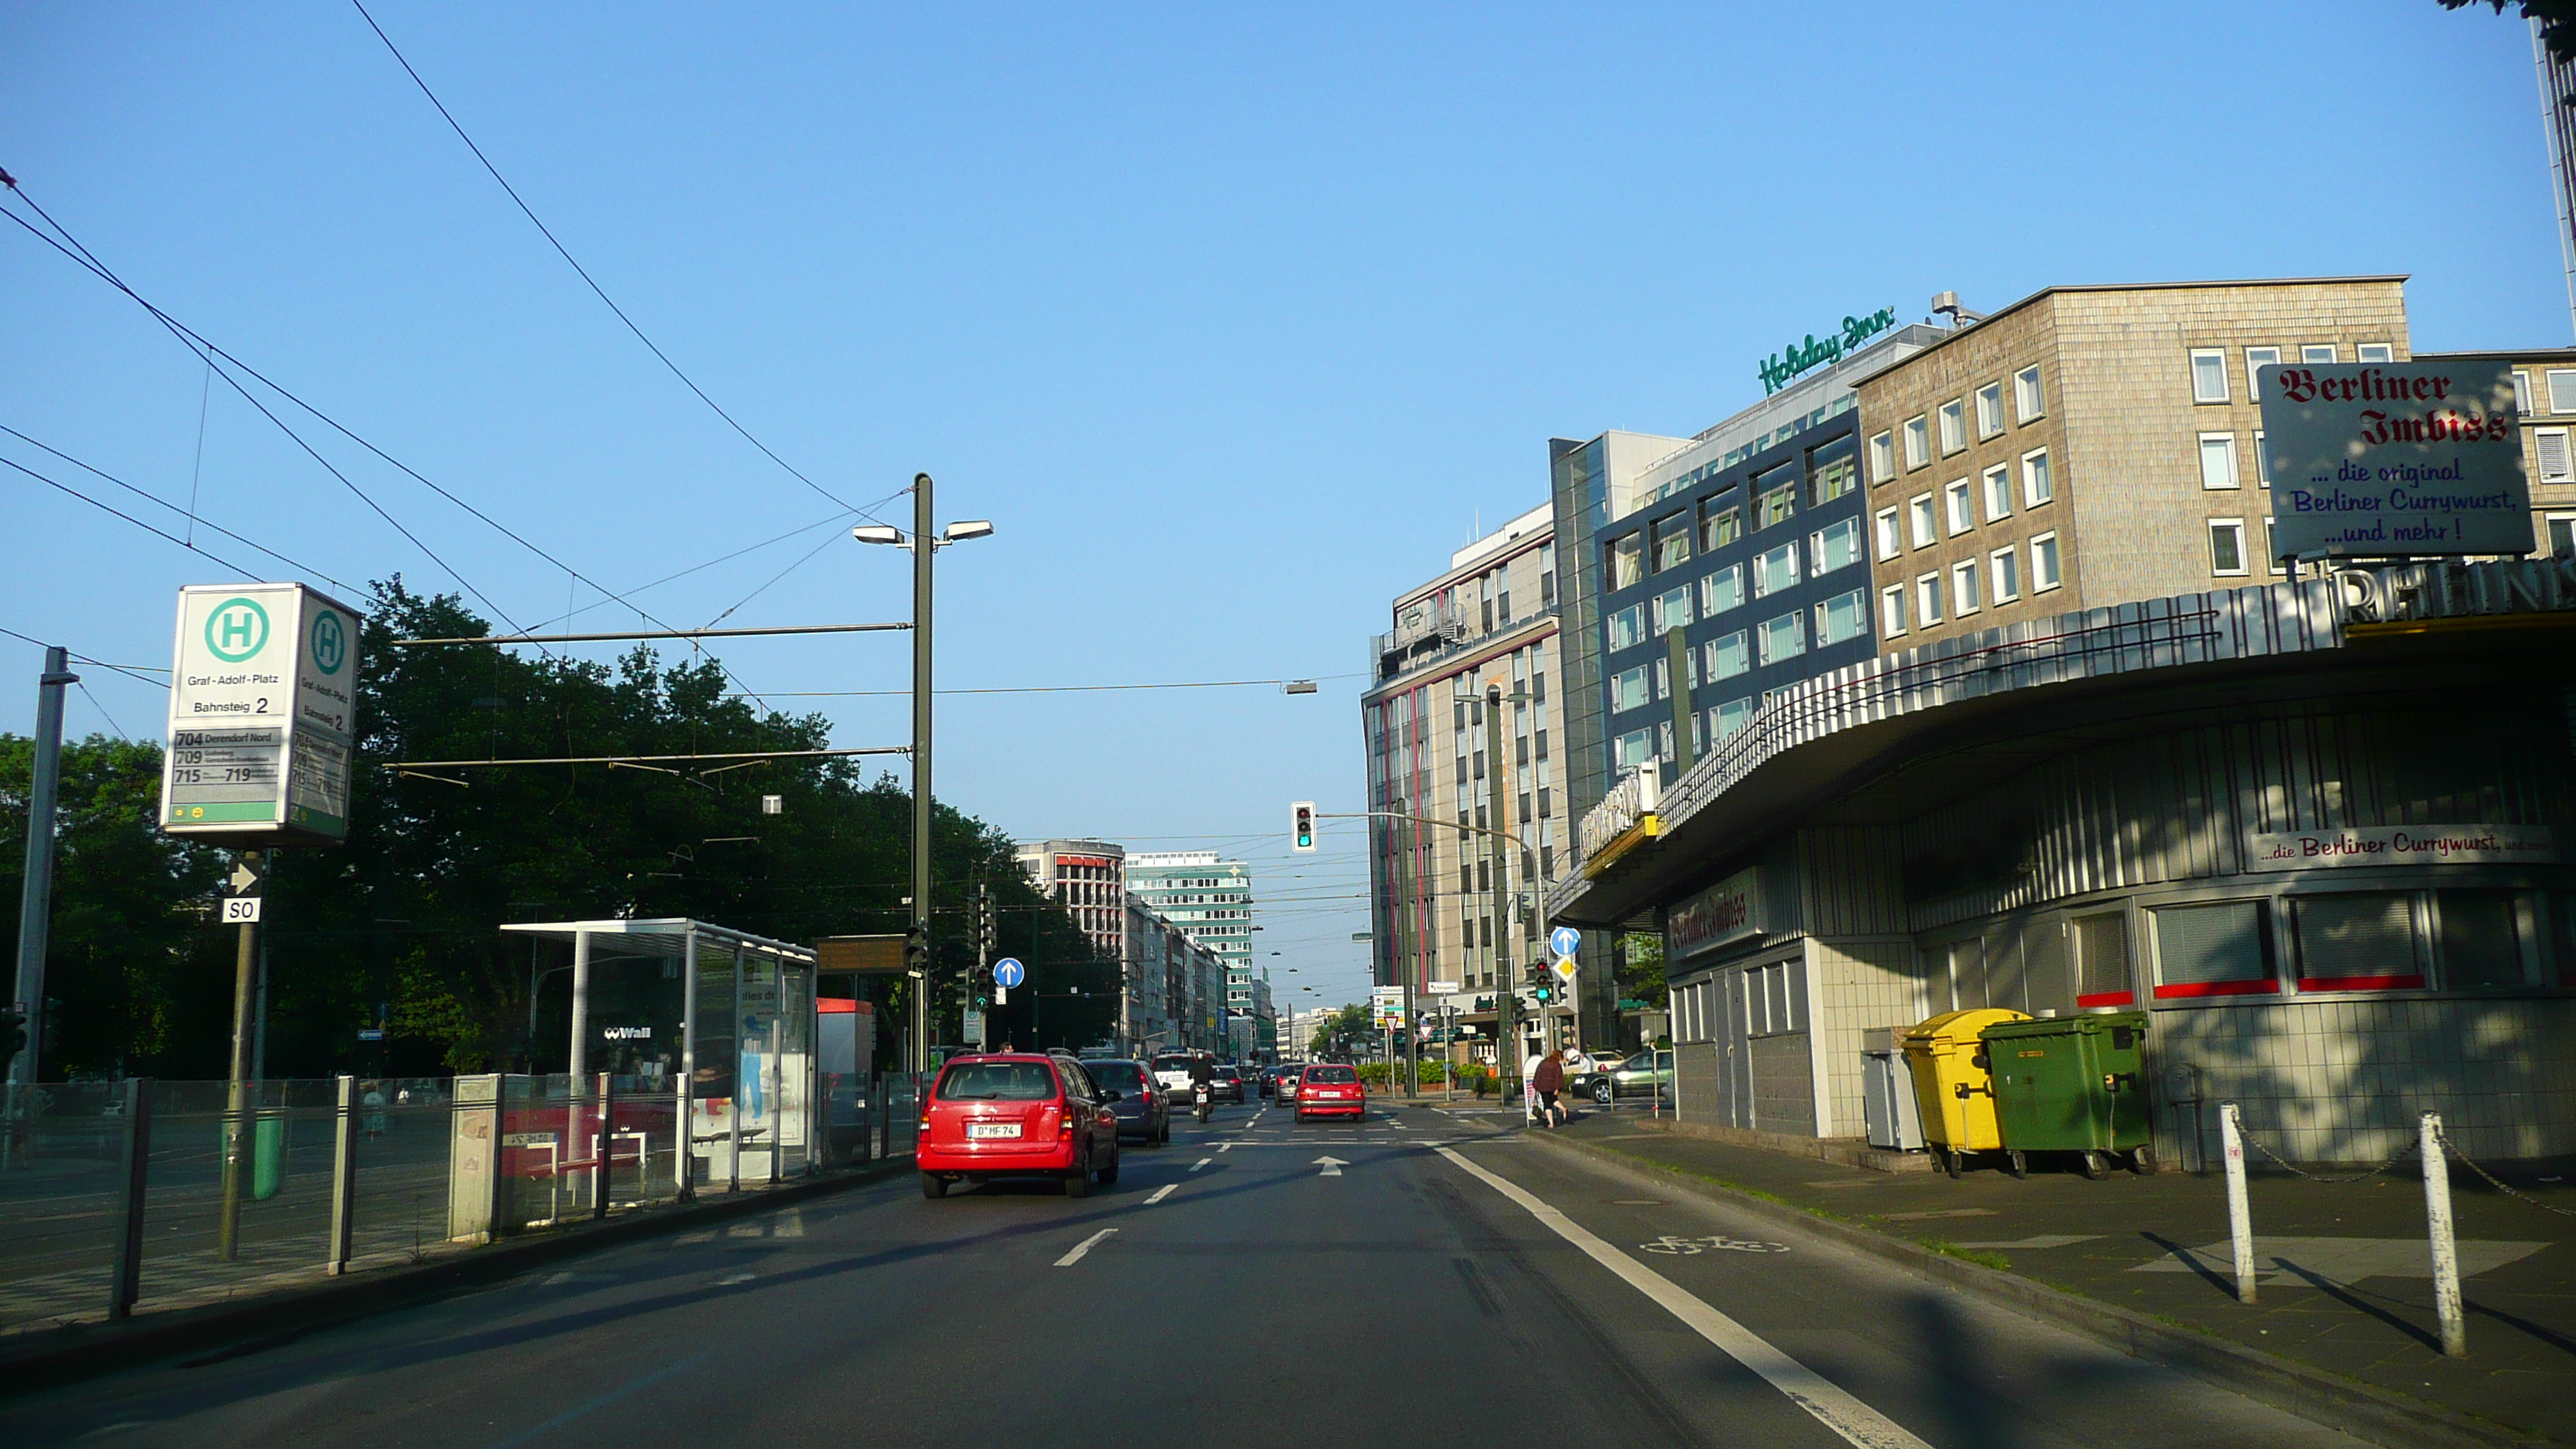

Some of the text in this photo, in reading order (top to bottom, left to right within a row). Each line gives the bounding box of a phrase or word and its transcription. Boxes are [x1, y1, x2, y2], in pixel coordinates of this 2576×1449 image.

[1758, 306, 1895, 394] Holiday Inn
[2280, 368, 2451, 402] Berliner
[2360, 409, 2508, 445] Imbiss
[2379, 457, 2465, 488] original
[2290, 488, 2516, 514] Berliner Currywurst,
[2394, 517, 2448, 542] mehr
[2332, 559, 2576, 625] RHEIN
[187, 674, 279, 686] Graf-Adolf-Platz
[194, 697, 268, 714] Bahnsteig 2
[335, 714, 343, 731] 2
[177, 732, 271, 746] 704 Derendorf Nord
[176, 751, 202, 764] 709
[176, 769, 200, 783] 715
[225, 769, 251, 782] 719
[2298, 834, 2387, 857] Berliner
[2393, 833, 2500, 857] Currywurst,
[229, 902, 254, 919] SO
[620, 1026, 652, 1039] Wall
